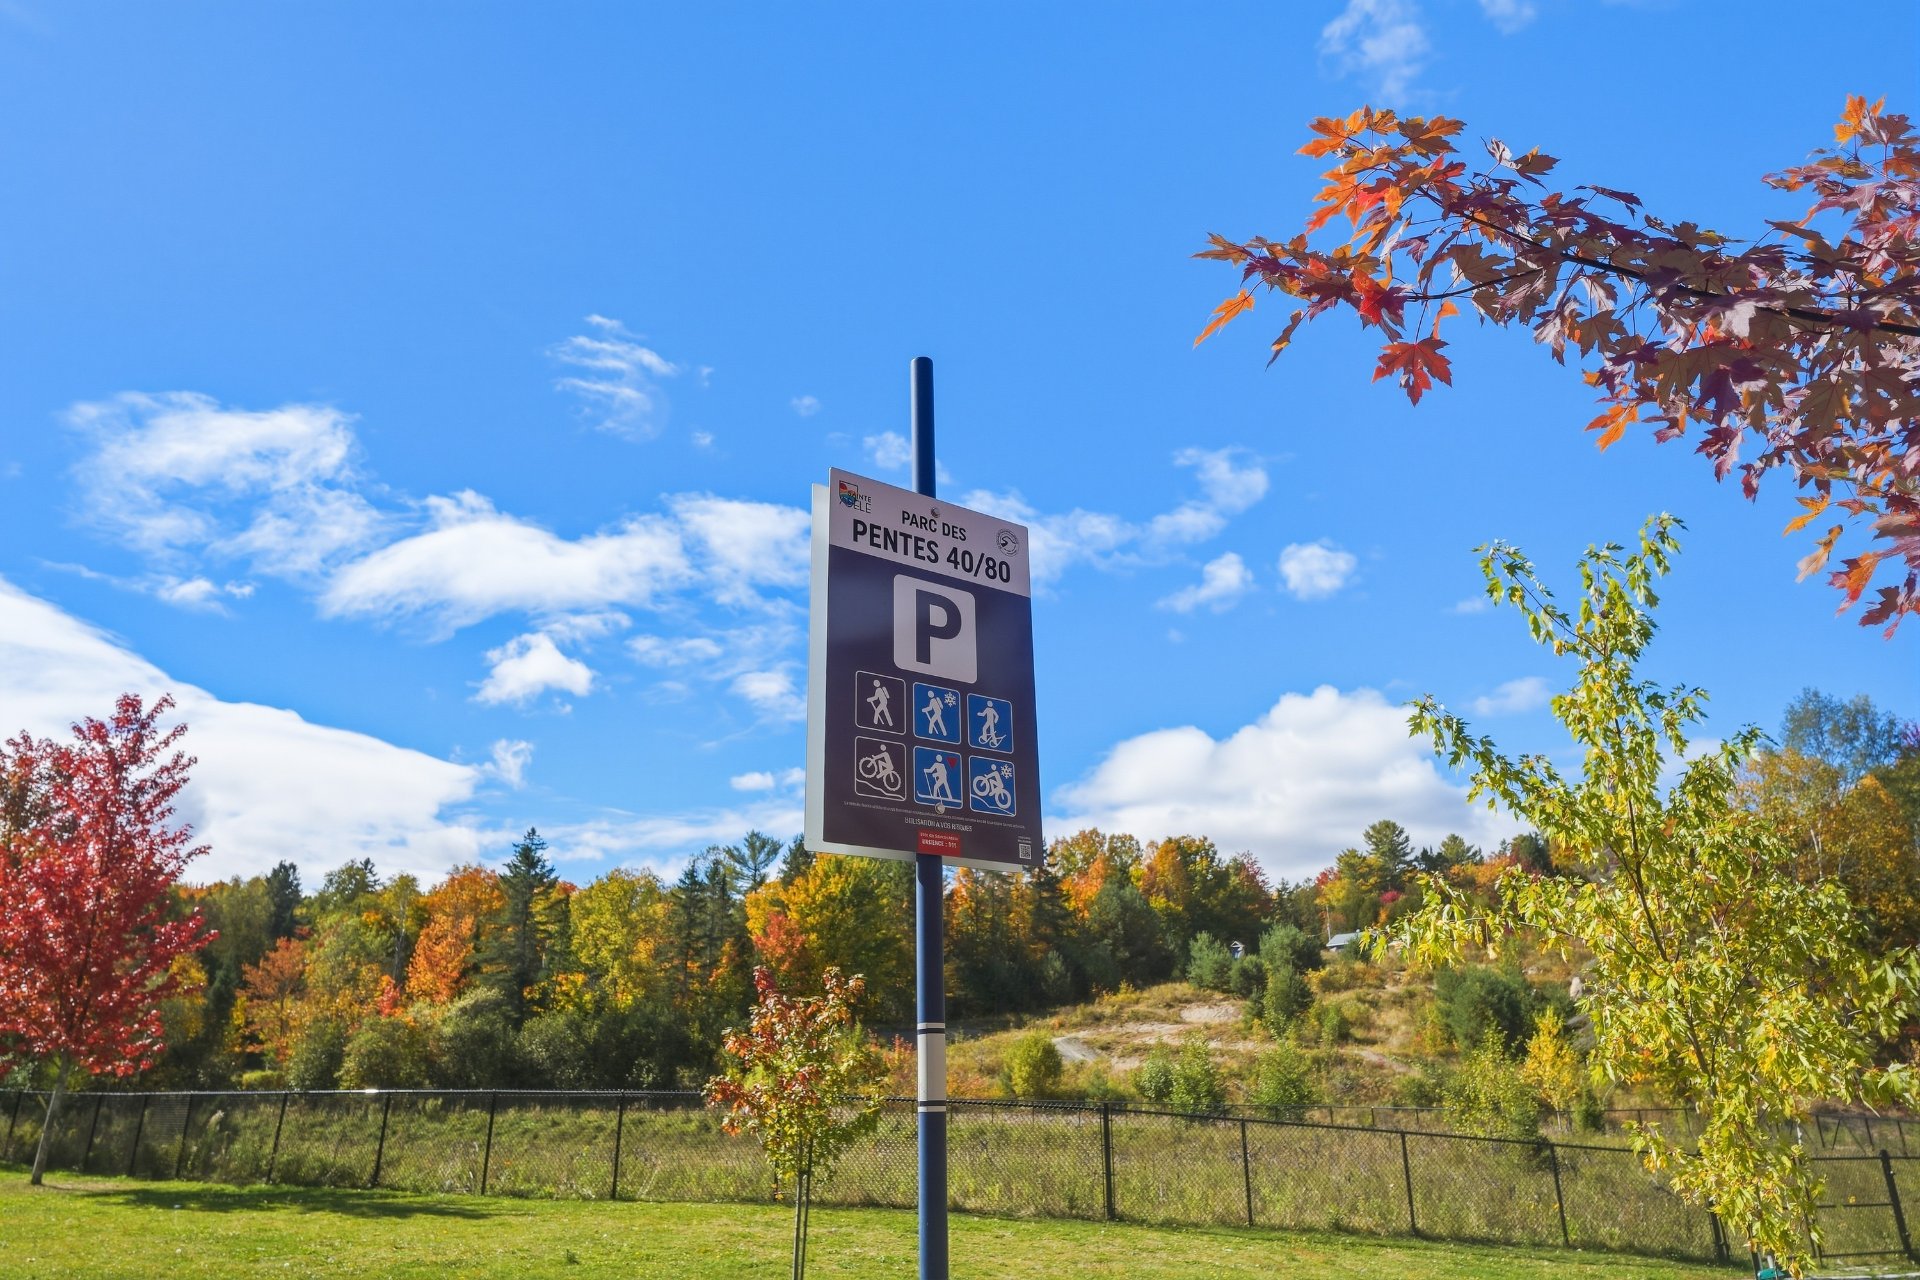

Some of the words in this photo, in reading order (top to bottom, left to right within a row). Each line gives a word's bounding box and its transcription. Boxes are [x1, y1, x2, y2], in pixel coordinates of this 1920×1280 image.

[853, 518, 939, 564] PENTES
[946, 547, 1011, 583] 40/80
[902, 510, 937, 533] PARC
[942, 522, 967, 541] DES
[915, 588, 962, 665] P
